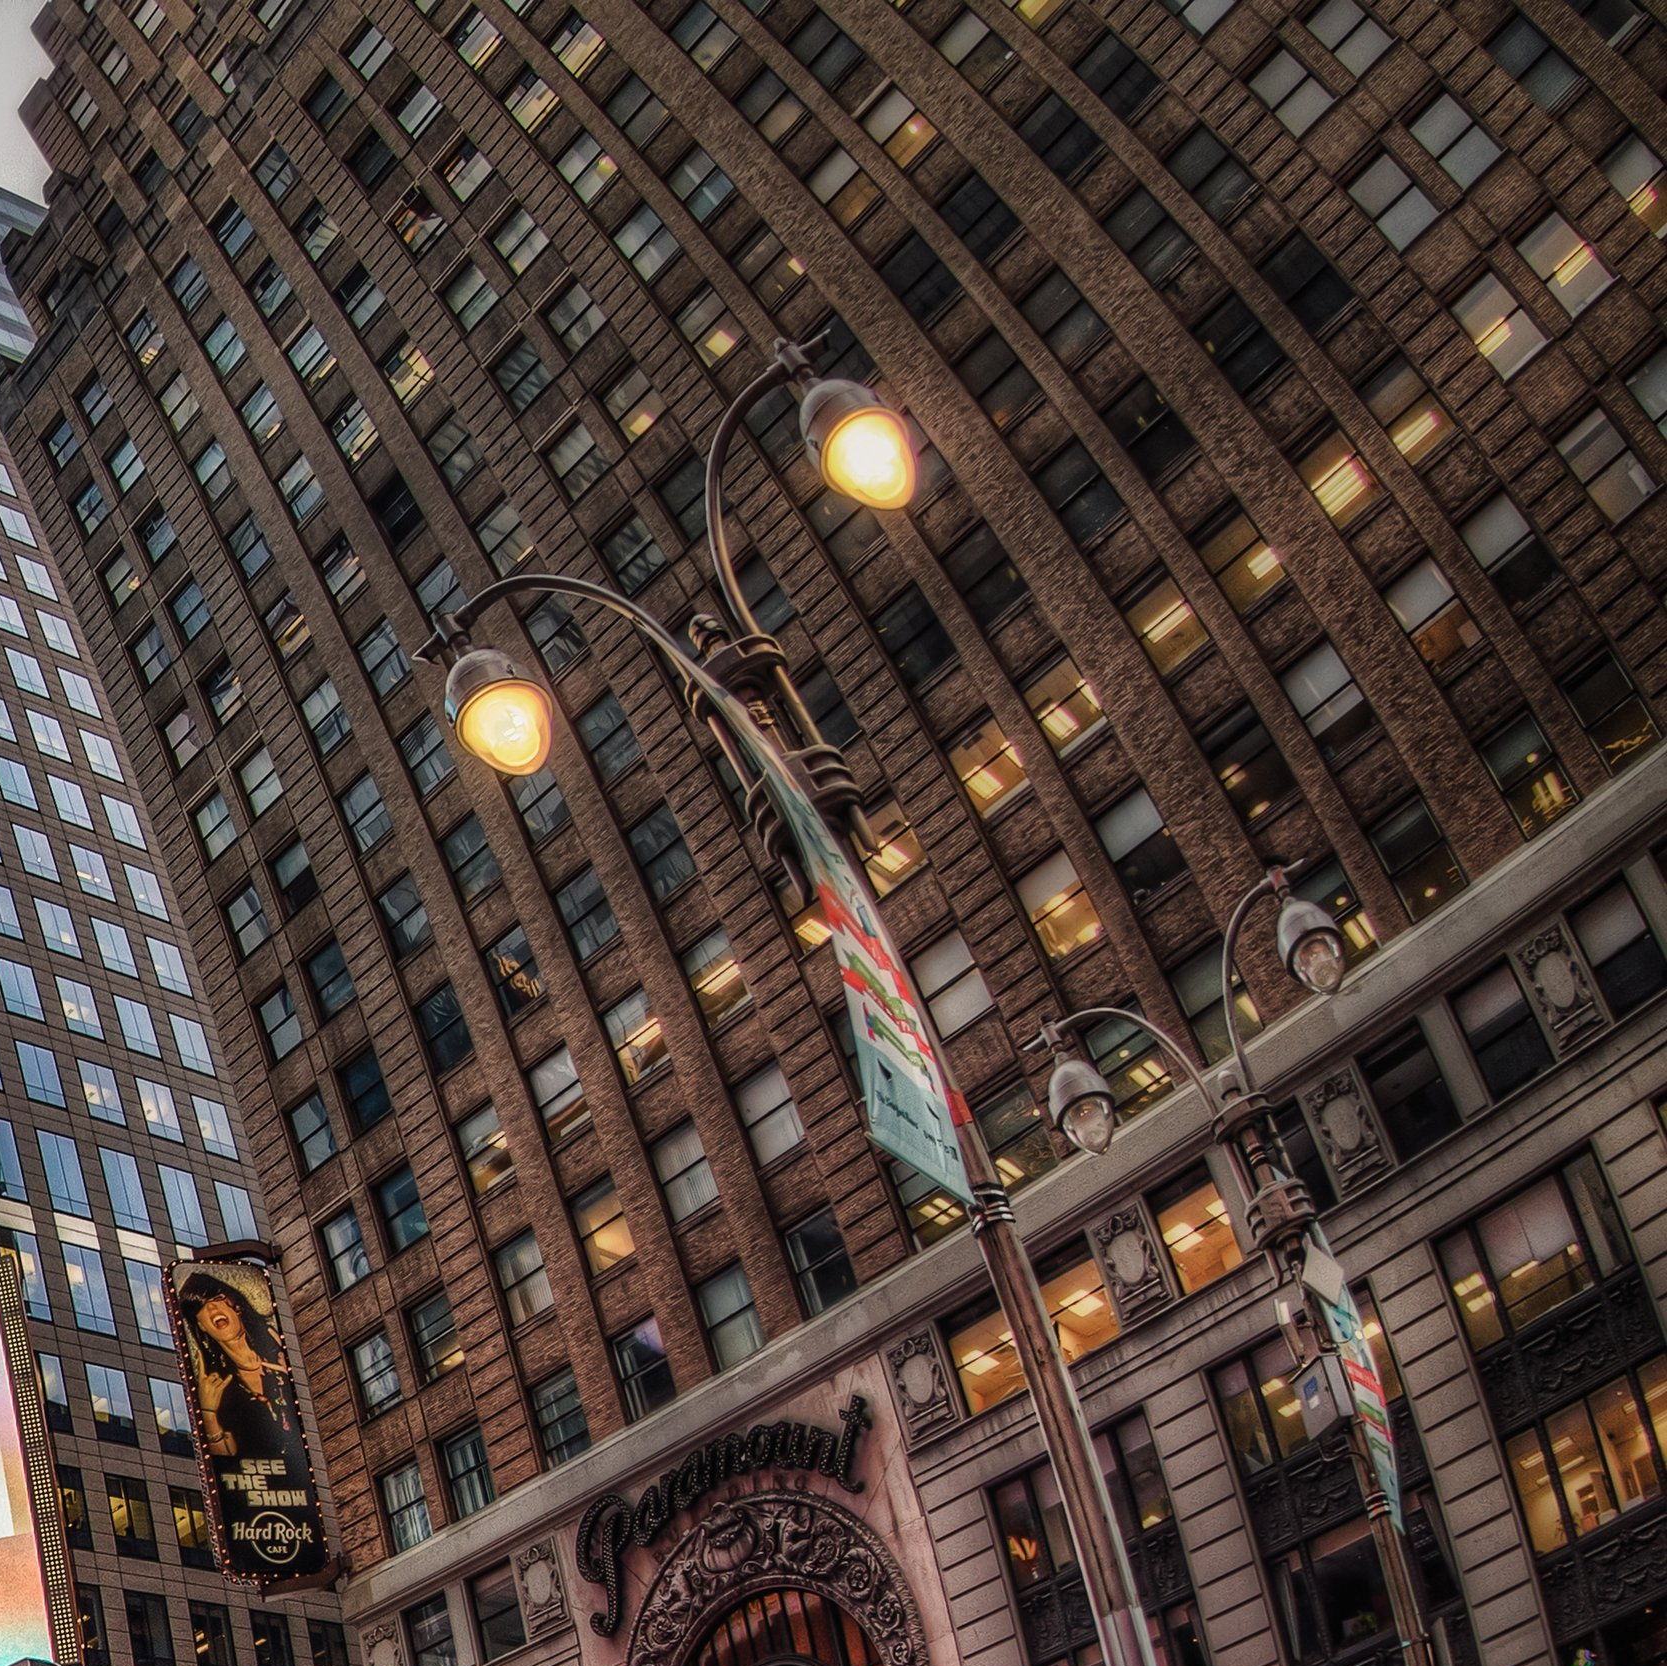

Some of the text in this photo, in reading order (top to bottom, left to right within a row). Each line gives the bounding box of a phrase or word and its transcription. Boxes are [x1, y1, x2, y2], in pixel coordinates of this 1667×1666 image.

[240, 1459, 287, 1476] SEE
[221, 1474, 267, 1490] THE
[247, 1489, 308, 1507] SHOW
[576, 1394, 875, 1638] Paramount
[232, 1521, 313, 1544] Hard Rock
